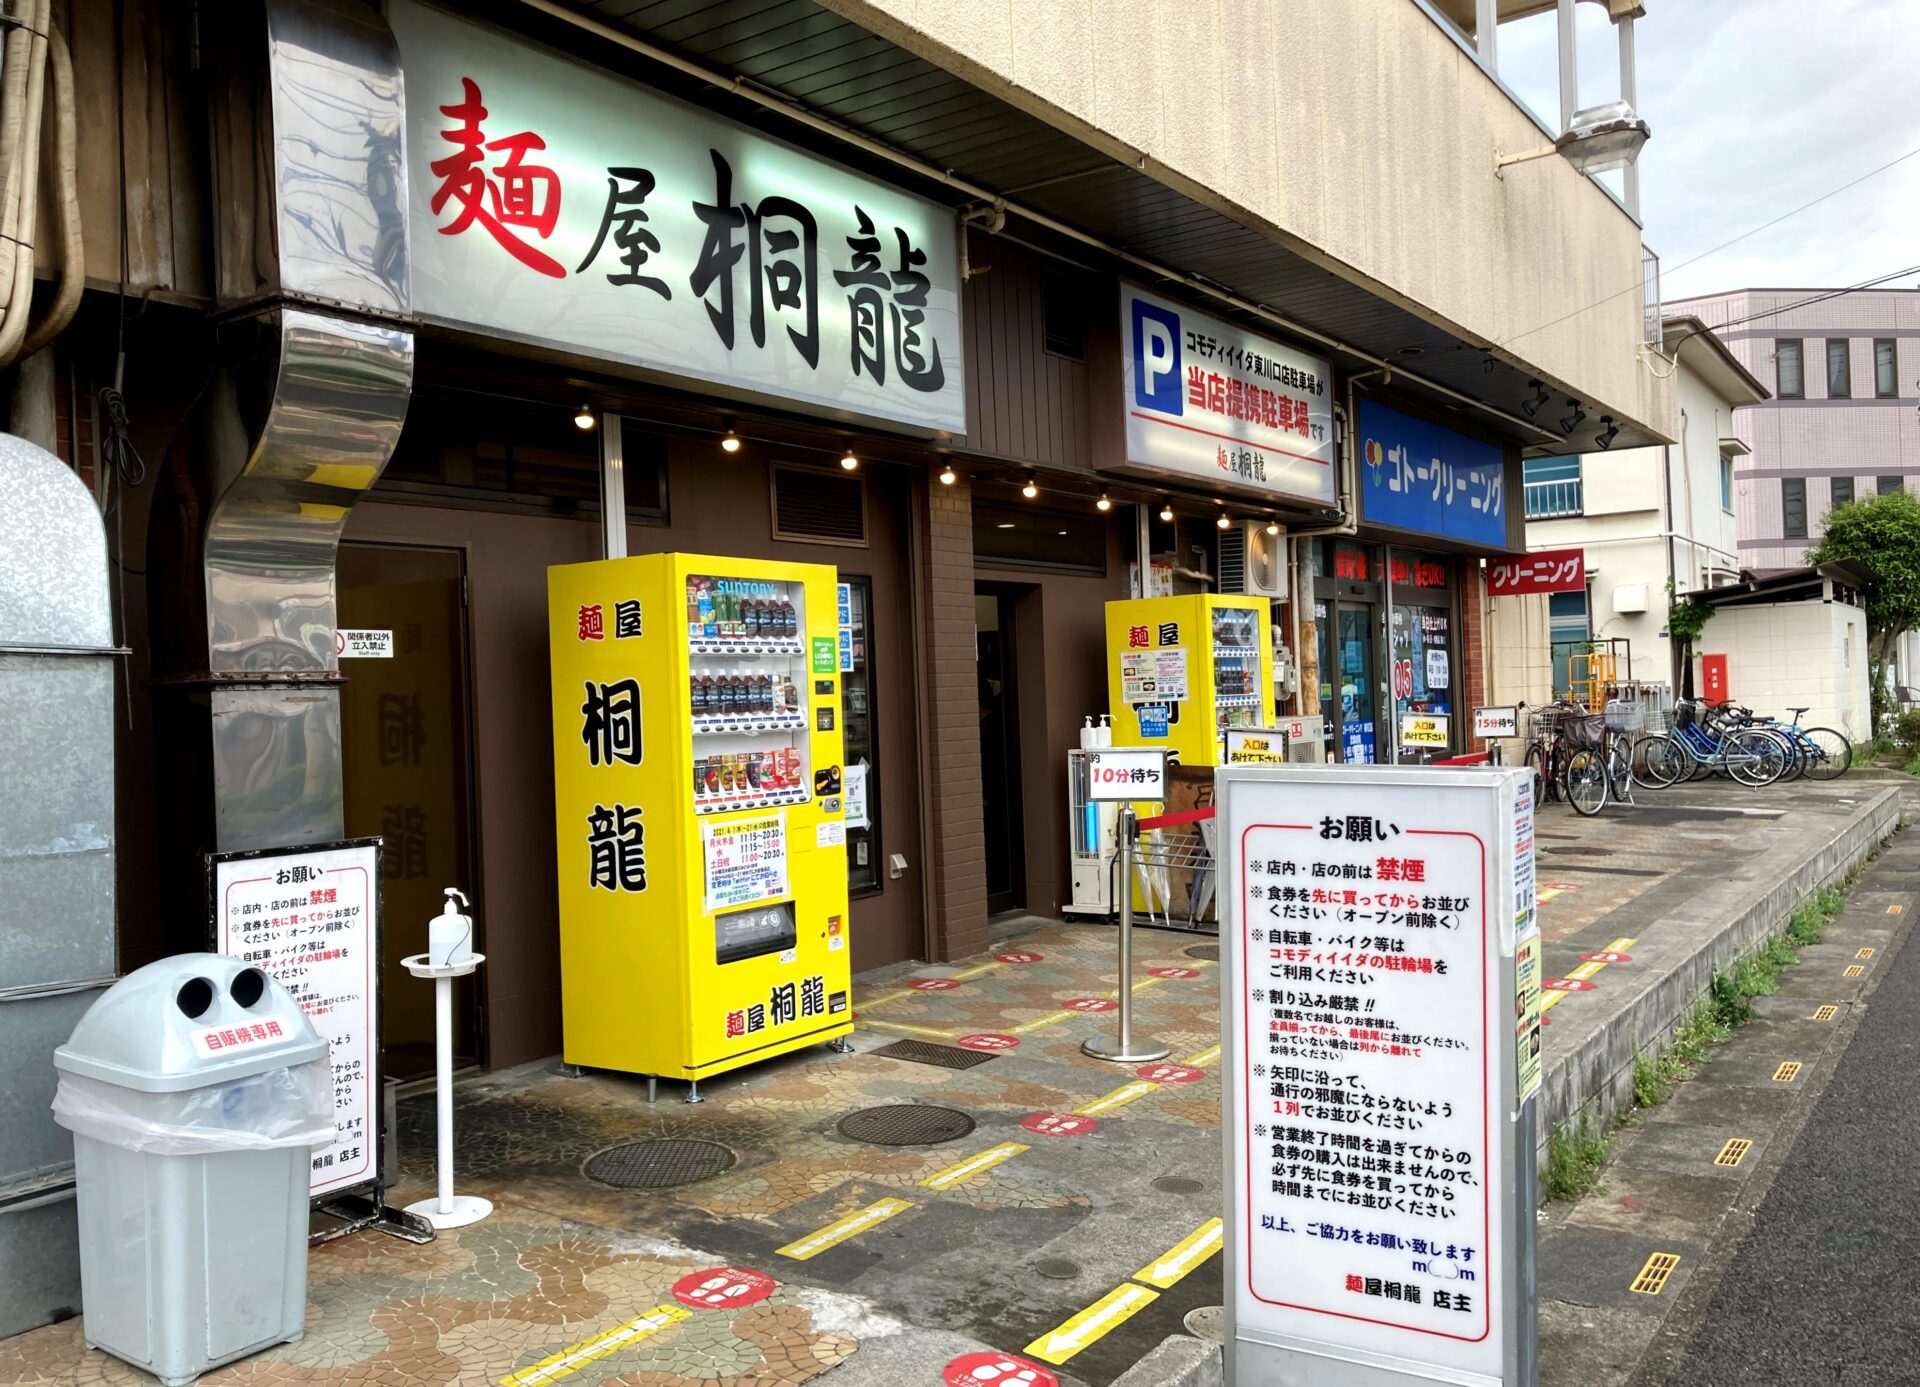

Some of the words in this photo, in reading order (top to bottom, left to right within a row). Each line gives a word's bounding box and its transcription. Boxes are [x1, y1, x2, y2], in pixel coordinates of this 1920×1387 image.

[430, 76, 945, 393] 麺屋桐龍
[1142, 316, 1174, 396] P
[1186, 331, 1324, 397] コモディイイダ東川口店駐車場が
[1187, 365, 1325, 442] 当店提携駐車場です
[1216, 444, 1267, 482] 麺屋桐龍
[1387, 443, 1502, 518] ゴトークリーニング
[1492, 556, 1580, 589] クリーニング
[717, 580, 775, 595] SUNTORY
[578, 600, 642, 641] 麺屋
[347, 632, 390, 641] 関係者以外
[352, 641, 386, 650] 立入禁止
[1129, 622, 1180, 648] 麺屋
[1404, 732, 1446, 741] あけて下さい
[1414, 721, 1436, 730] 入口は
[1478, 718, 1515, 728] 15分待ち
[1089, 753, 1101, 764] 約
[1231, 752, 1282, 763] あけて下さい
[1243, 739, 1270, 750] 入口は
[581, 677, 647, 892] 桐龍
[1092, 767, 1160, 785] 10分待ち
[1319, 815, 1400, 842] お願い
[276, 865, 324, 885] お願い
[1269, 948, 1448, 975] コモディイイダの駐輪場を
[1269, 964, 1375, 986] ご利用ください
[726, 976, 825, 1039] 麺屋桐龍
[204, 1020, 284, 1050] 自販機専用
[1269, 1019, 1470, 1052] 全員揃ってから、最後尾にお並びください。
[1269, 1031, 1422, 1058] 揃っていない場合は列から離れて
[1269, 1045, 1344, 1062] お待ちください）
[1270, 1082, 1453, 1118] 通行の邪魔にならないよう
[312, 1154, 334, 1171] 桐龍
[339, 1147, 361, 1162] 店主
[1271, 1143, 1479, 1186] 食券の購入は出来ませんので、
[1271, 1162, 1455, 1201] 必ず先に食券を買ってから
[1271, 1179, 1456, 1219] 時間までにお並びください
[1261, 1214, 1476, 1262] 以上、ご協力をお願い致します
[1345, 1273, 1421, 1304] 麺屋桐龍
[1432, 1289, 1472, 1313] 店主
